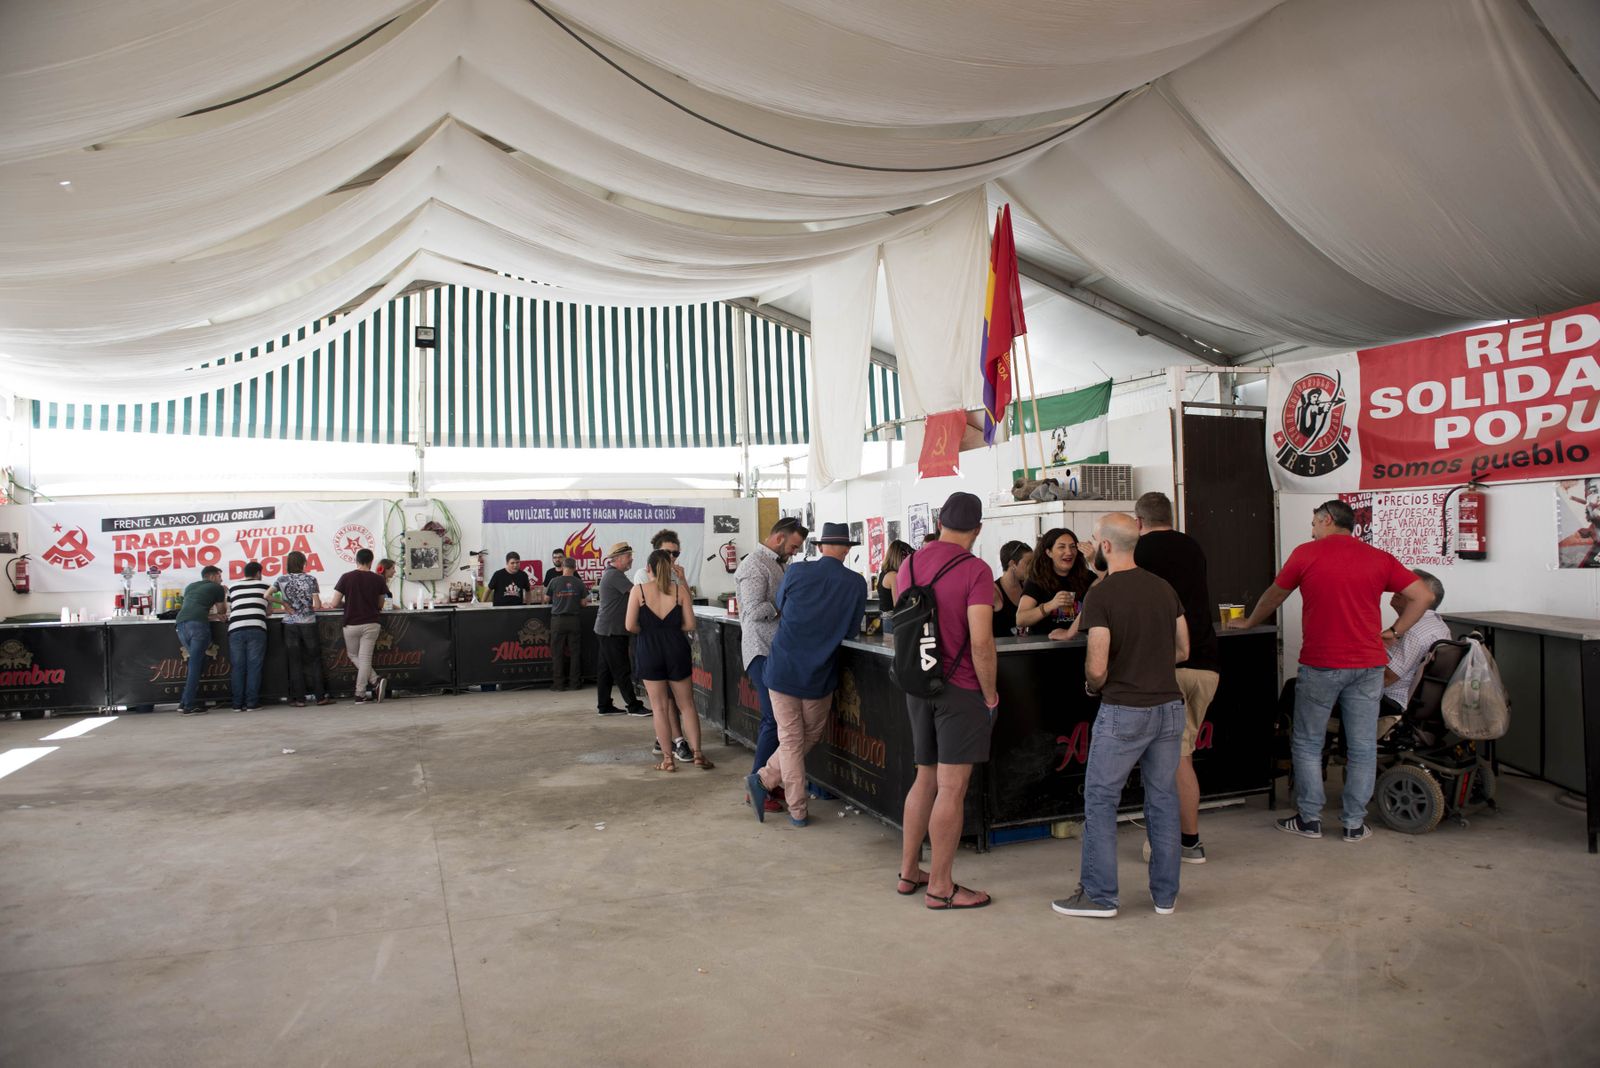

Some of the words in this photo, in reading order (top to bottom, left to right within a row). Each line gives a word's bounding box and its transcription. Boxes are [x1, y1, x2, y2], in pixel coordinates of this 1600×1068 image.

[1465, 313, 1600, 369] RED
[1369, 355, 1600, 420] SOLIDA
[1434, 399, 1600, 450] POPU
[1372, 457, 1464, 480] somos
[1471, 440, 1590, 477] pueblo
[1350, 500, 1372, 510] DIGN
[1357, 493, 1372, 501] VID
[114, 518, 151, 529] FRENTE
[153, 517, 167, 527] AL
[168, 515, 200, 525] PARO,
[202, 512, 229, 523] LUCHA
[231, 509, 264, 521] OBRERA
[507, 506, 553, 521] MOVILÍZATE,
[553, 508, 569, 519] QUE
[571, 508, 581, 519] NO
[581, 508, 591, 519] TE
[592, 508, 617, 520] HAGAN
[619, 508, 643, 520] PAGAR
[644, 508, 653, 520] LA
[654, 508, 677, 520] CRISIS
[112, 528, 220, 551] TRABAJO
[235, 525, 277, 542] para
[281, 523, 314, 535] una
[239, 535, 312, 559] VIDA
[48, 555, 89, 570] PCE
[114, 545, 221, 574] DIGNO
[229, 553, 324, 580] DGA
[920, 622, 937, 671] FILA
